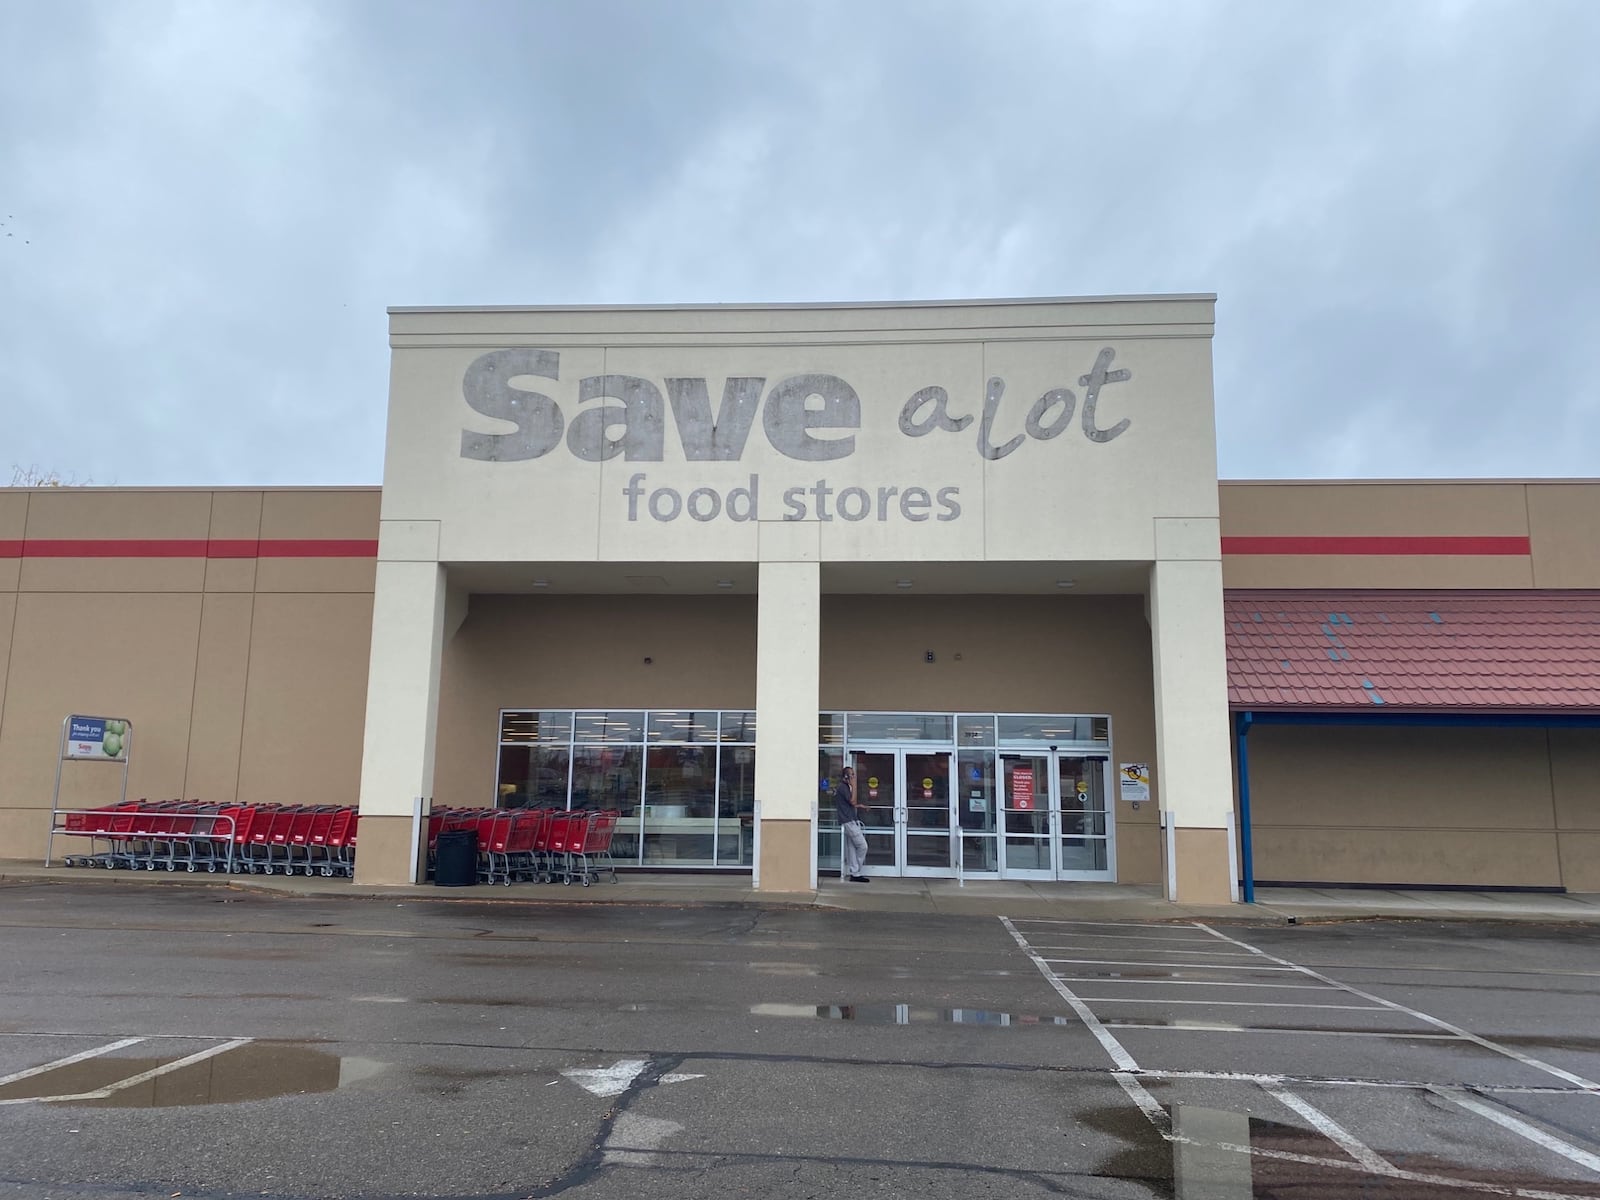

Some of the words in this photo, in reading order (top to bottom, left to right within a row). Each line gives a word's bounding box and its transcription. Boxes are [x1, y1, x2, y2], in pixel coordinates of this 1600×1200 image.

[460, 348, 862, 462] Save
[622, 473, 758, 522] food
[782, 478, 961, 522] stores
